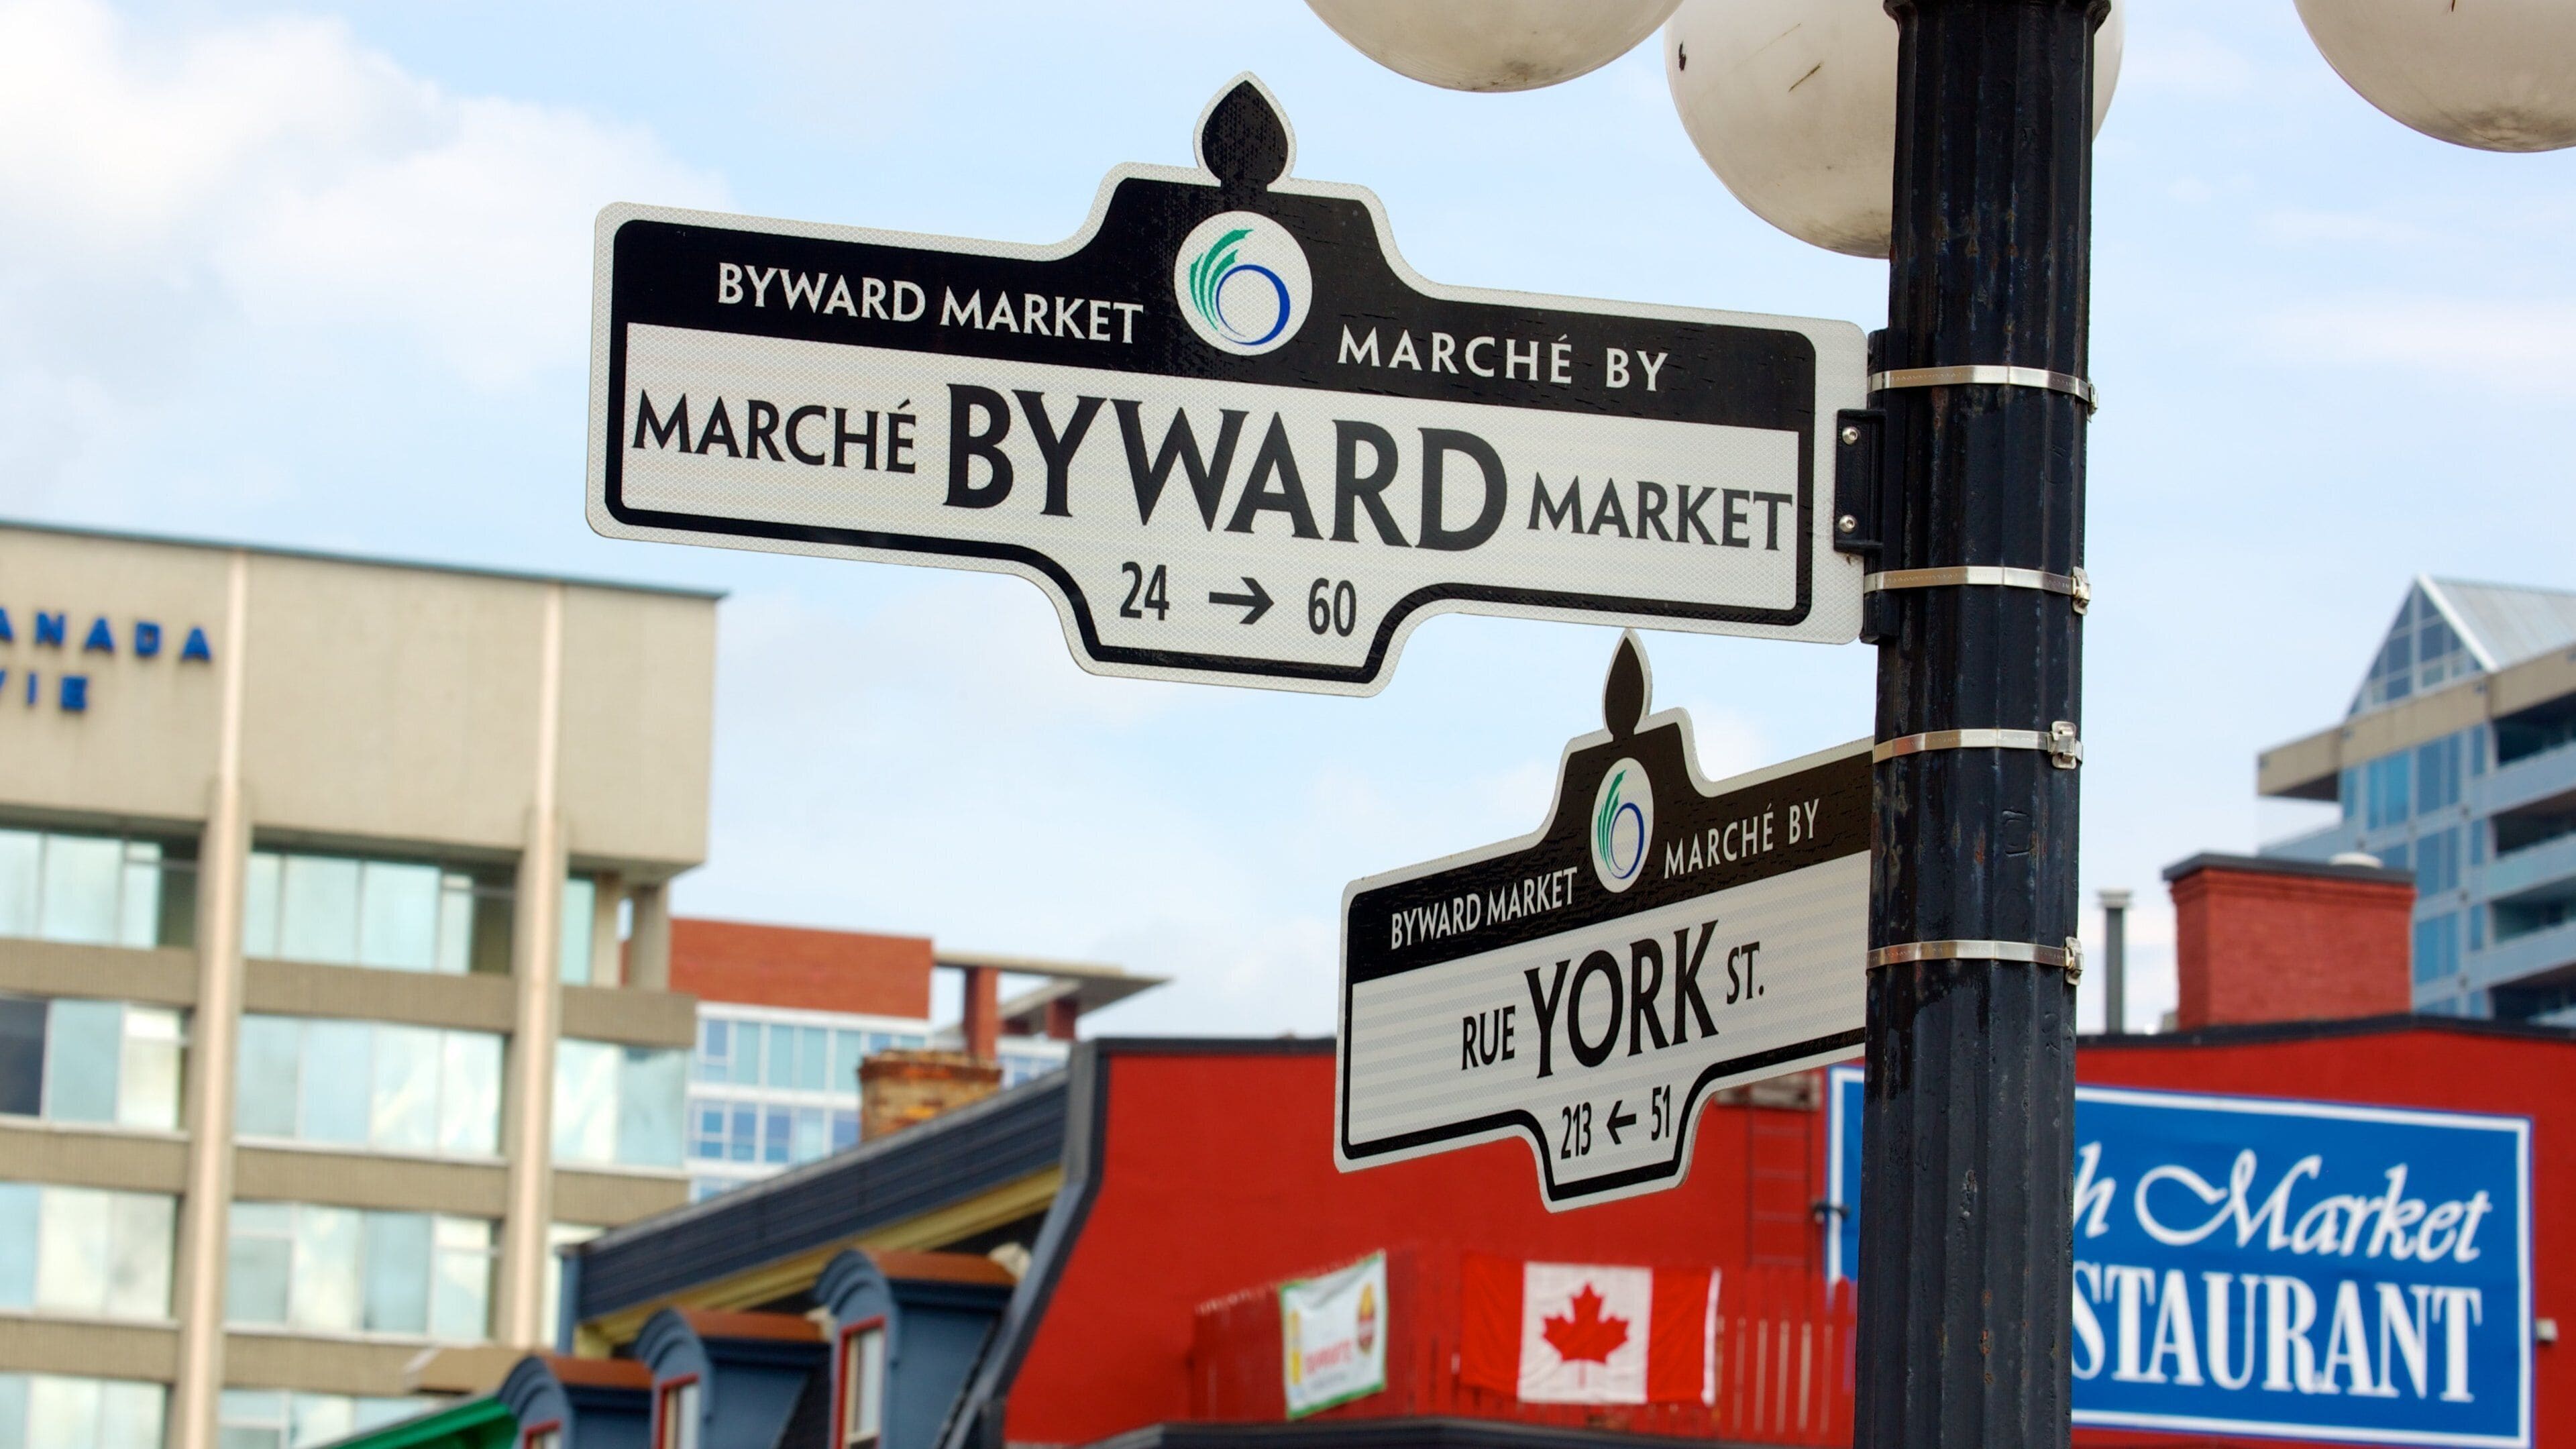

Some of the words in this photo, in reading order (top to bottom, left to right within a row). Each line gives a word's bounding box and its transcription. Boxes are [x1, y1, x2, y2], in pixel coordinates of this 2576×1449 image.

[718, 262, 926, 322] BYWARD
[940, 286, 1144, 344] MARKET
[1337, 324, 1572, 384] MARCHÉ
[1606, 347, 1668, 392] BY
[631, 388, 916, 474] MARCHÉ
[943, 383, 1507, 552] BYWARD
[1526, 472, 1793, 551] MARKET
[1120, 561, 1170, 621] 24
[1308, 577, 1356, 637] 60
[0, 669, 88, 712] IE
[1664, 804, 1774, 879] MARCHÉ
[1788, 798, 1819, 845] BY
[1391, 893, 1481, 950] BYWARD
[1486, 866, 1578, 926] MARKET
[1461, 1005, 1516, 1071] RUE
[1523, 919, 1719, 1079] YORK
[1726, 941, 1764, 1005] ST.
[1560, 1102, 1592, 1160] 213
[1651, 1084, 1670, 1141] 51
[2135, 1148, 2493, 1263] Market
